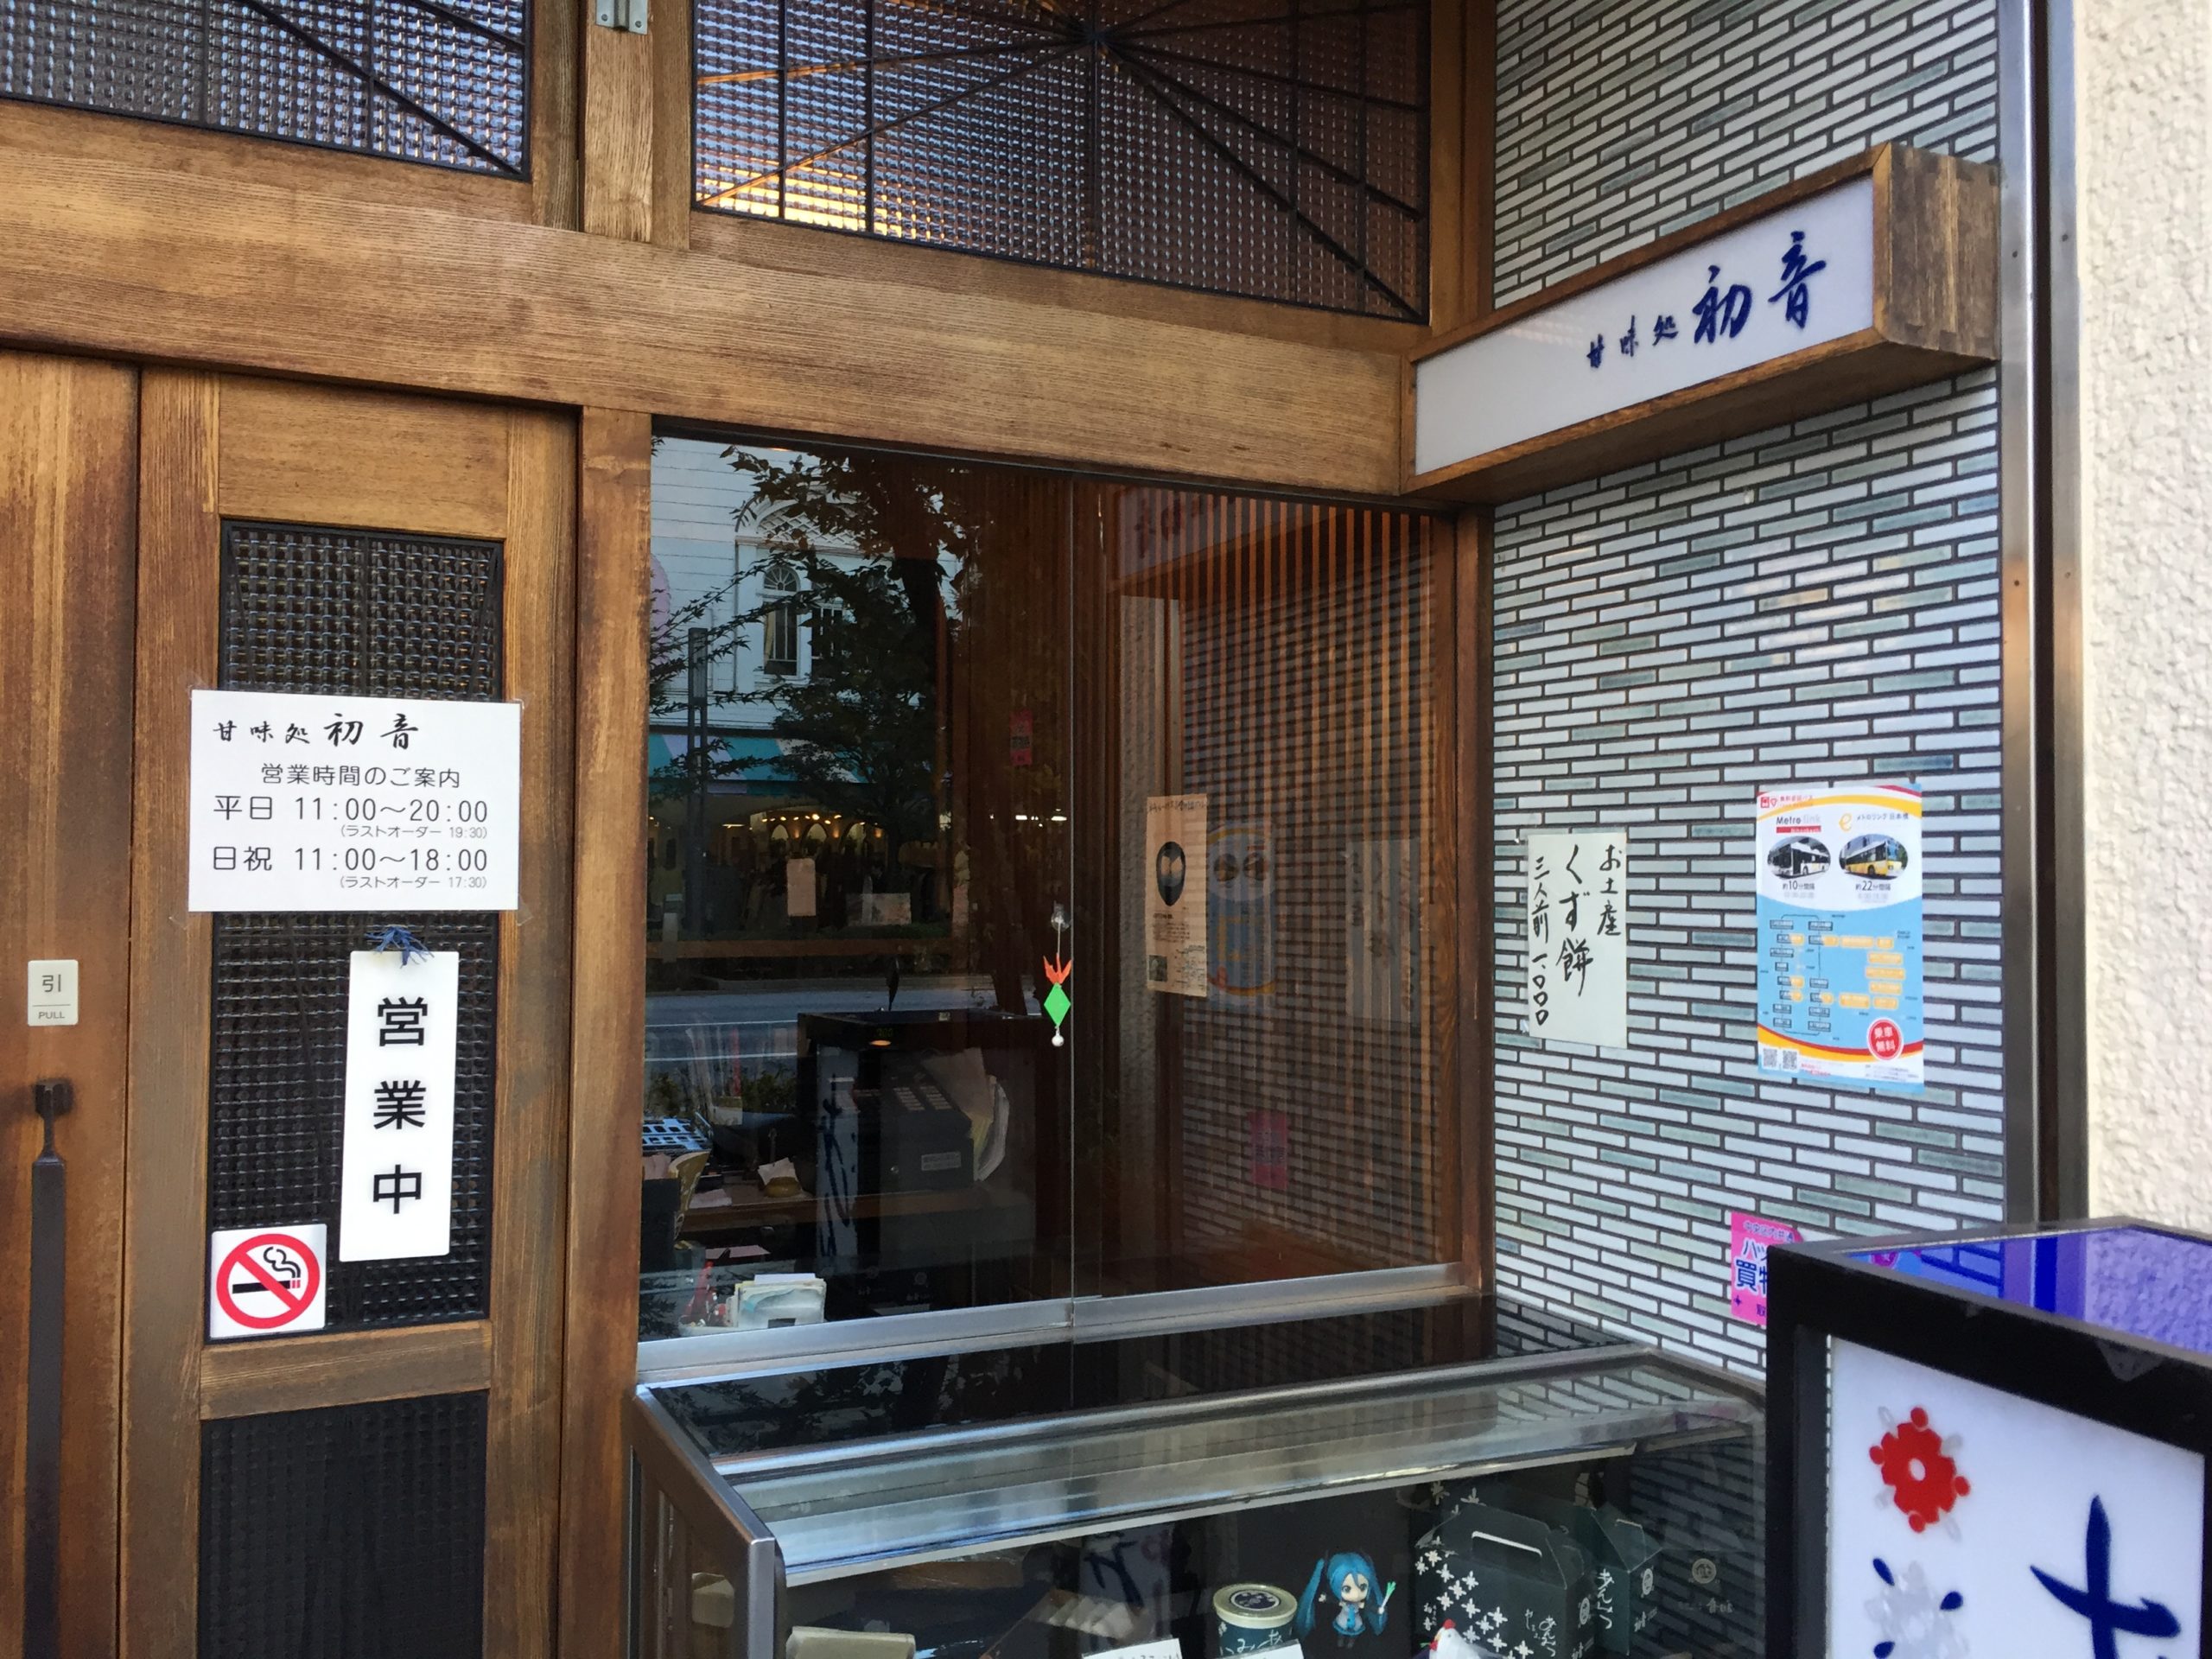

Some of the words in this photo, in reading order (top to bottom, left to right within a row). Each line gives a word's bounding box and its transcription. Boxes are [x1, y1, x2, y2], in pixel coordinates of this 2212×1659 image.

[261, 763, 461, 789] 営業時間のご案内
[213, 795, 273, 821] 平日
[1776, 816, 1802, 825] Metro
[213, 846, 273, 872] 日祝
[1555, 843, 1595, 998] くず餅
[41, 974, 62, 994] 引
[38, 1010, 66, 1020] PULL
[372, 995, 429, 1215] 営業中
